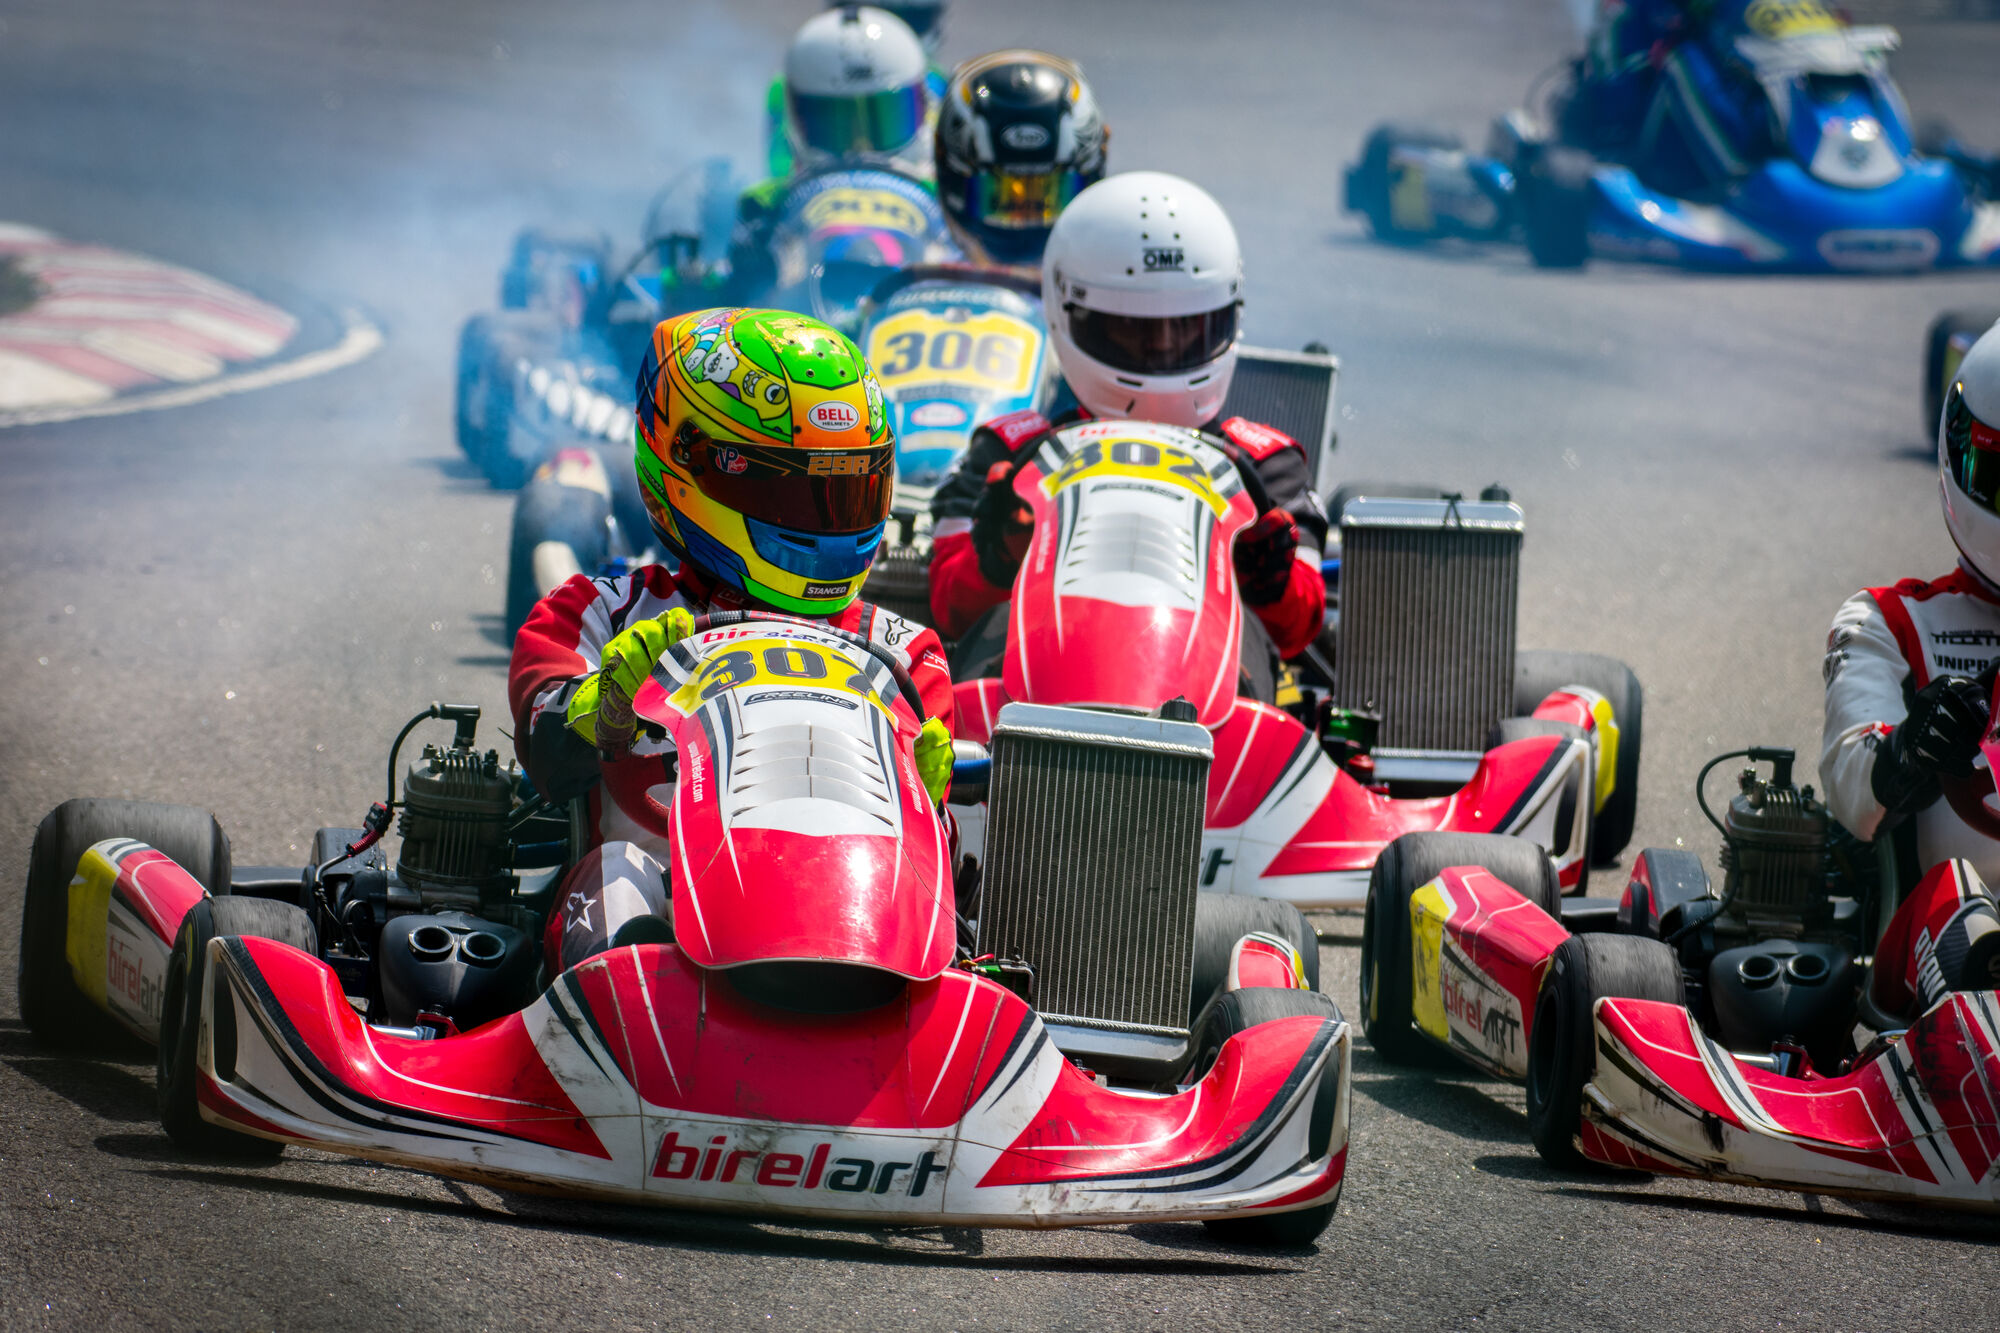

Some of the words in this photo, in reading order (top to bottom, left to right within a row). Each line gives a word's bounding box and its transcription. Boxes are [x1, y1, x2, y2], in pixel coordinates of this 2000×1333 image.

[1143, 251, 1185, 268] OMP
[881, 331, 1020, 382] 306
[817, 408, 854, 421] BELL
[717, 447, 739, 473] VP
[807, 455, 871, 475] 29R
[807, 586, 847, 595] STANCED
[1914, 925, 1947, 1004] RYAN
[650, 1131, 948, 1198] birelart
